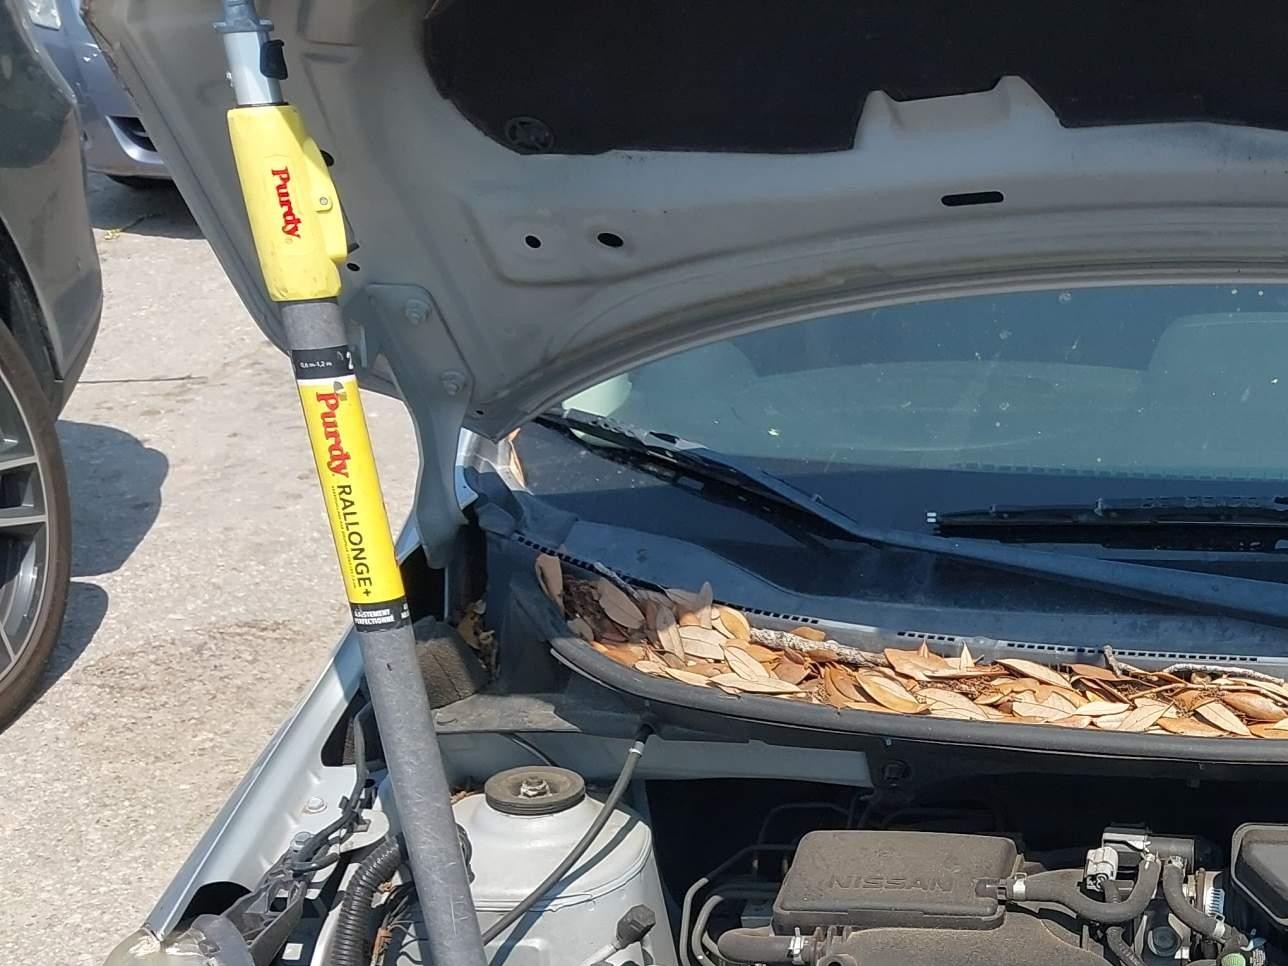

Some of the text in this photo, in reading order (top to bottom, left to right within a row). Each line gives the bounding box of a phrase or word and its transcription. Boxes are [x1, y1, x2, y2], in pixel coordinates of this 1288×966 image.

[271, 166, 302, 239] Purdy
[316, 391, 351, 478] Purdy
[337, 485, 372, 597] RALLONGE+
[830, 875, 952, 893] NISSAN
